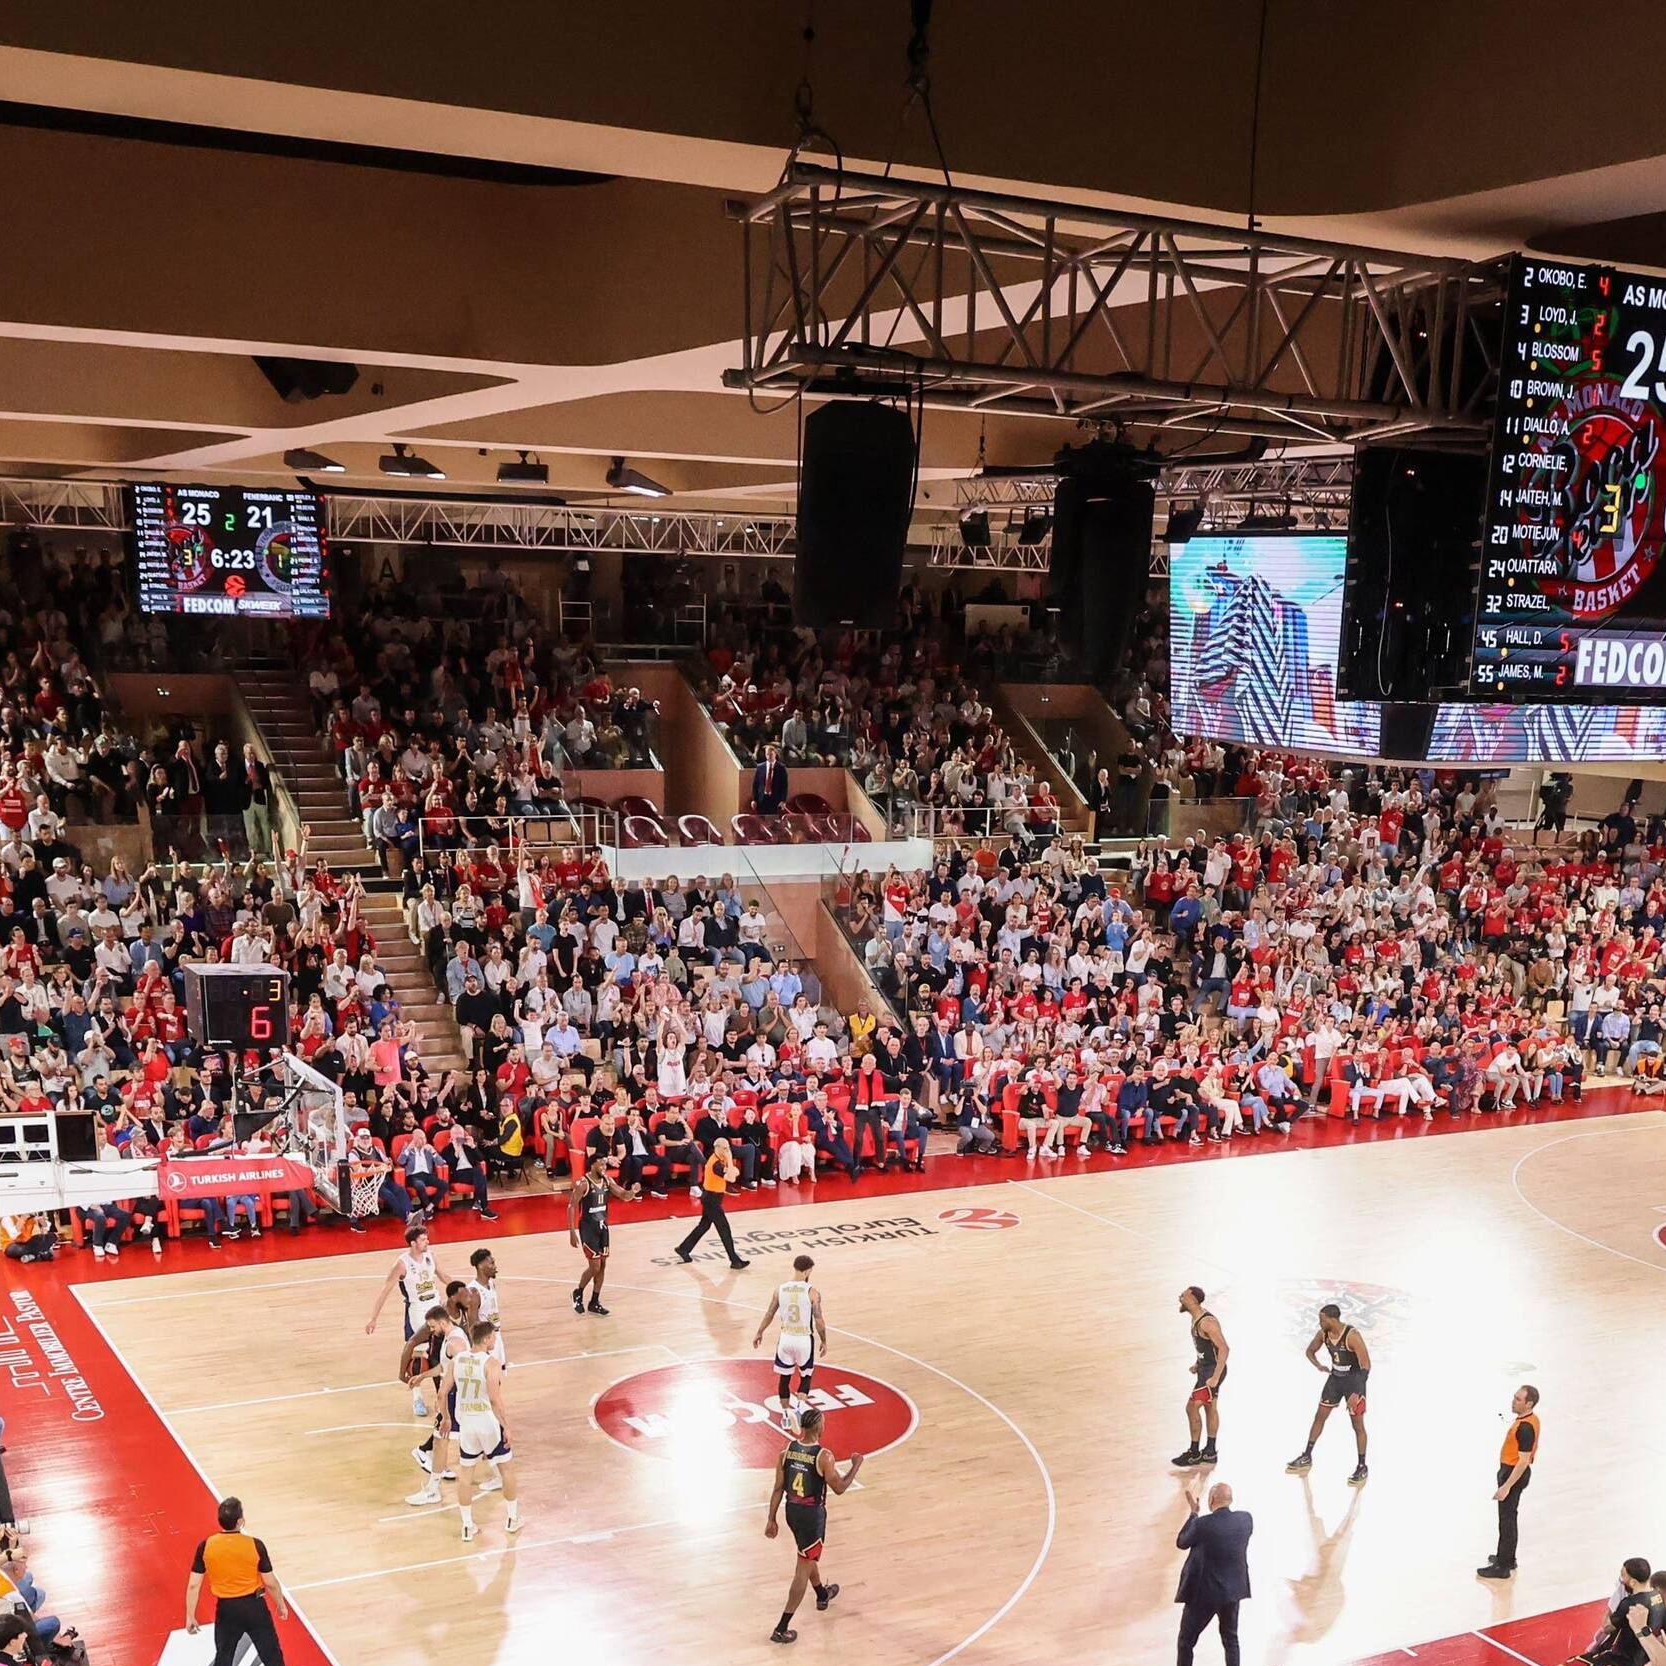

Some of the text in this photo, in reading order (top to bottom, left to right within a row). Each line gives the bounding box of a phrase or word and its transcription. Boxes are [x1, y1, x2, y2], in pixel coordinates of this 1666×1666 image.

[1524, 267, 1610, 296] 2 OKOBO, E. 4
[1623, 284, 1646, 306] AS
[1520, 305, 1607, 335] 3 LOYD, J. 2
[1518, 342, 1602, 371] 4 BLOSSOM 5
[1510, 380, 1522, 398] 10
[1527, 380, 1565, 399] BROWN,
[1566, 385, 1575, 399] J.
[1506, 417, 1518, 435] 11
[1561, 422, 1571, 436] A.
[1583, 424, 1593, 443] 2
[1502, 453, 1568, 474] 12 CORNELIE,
[188, 489, 220, 499] MONACO
[1500, 489, 1563, 508] 14 JAITEH, M.
[182, 502, 212, 526] 25
[247, 505, 273, 529] 21
[1600, 484, 1621, 534] 3
[225, 513, 237, 531] 2
[1491, 526, 1508, 544] 20
[1512, 525, 1560, 542] MOTIEJUN
[184, 549, 192, 566] 3
[211, 548, 256, 569] 6:23
[1489, 559, 1558, 578] 24 OUATTARA
[1572, 563, 1641, 612] BASKET
[183, 598, 236, 614] FEDCOM
[237, 599, 283, 611] SKWEEK
[1485, 594, 1551, 613] 32 STRAZEL,
[1481, 631, 1570, 653] 45 HALL, D. 5
[1478, 664, 1567, 686] 55 JAMES, M. 2
[269, 979, 281, 1001] 3
[252, 1006, 270, 1038] 6
[189, 1169, 285, 1186] TURKISH AIRLINES
[801, 1226, 940, 1249] TURKISH
[61, 1376, 105, 1422] CENTRE
[457, 1377, 481, 1399] 77
[792, 1472, 806, 1498] 4
